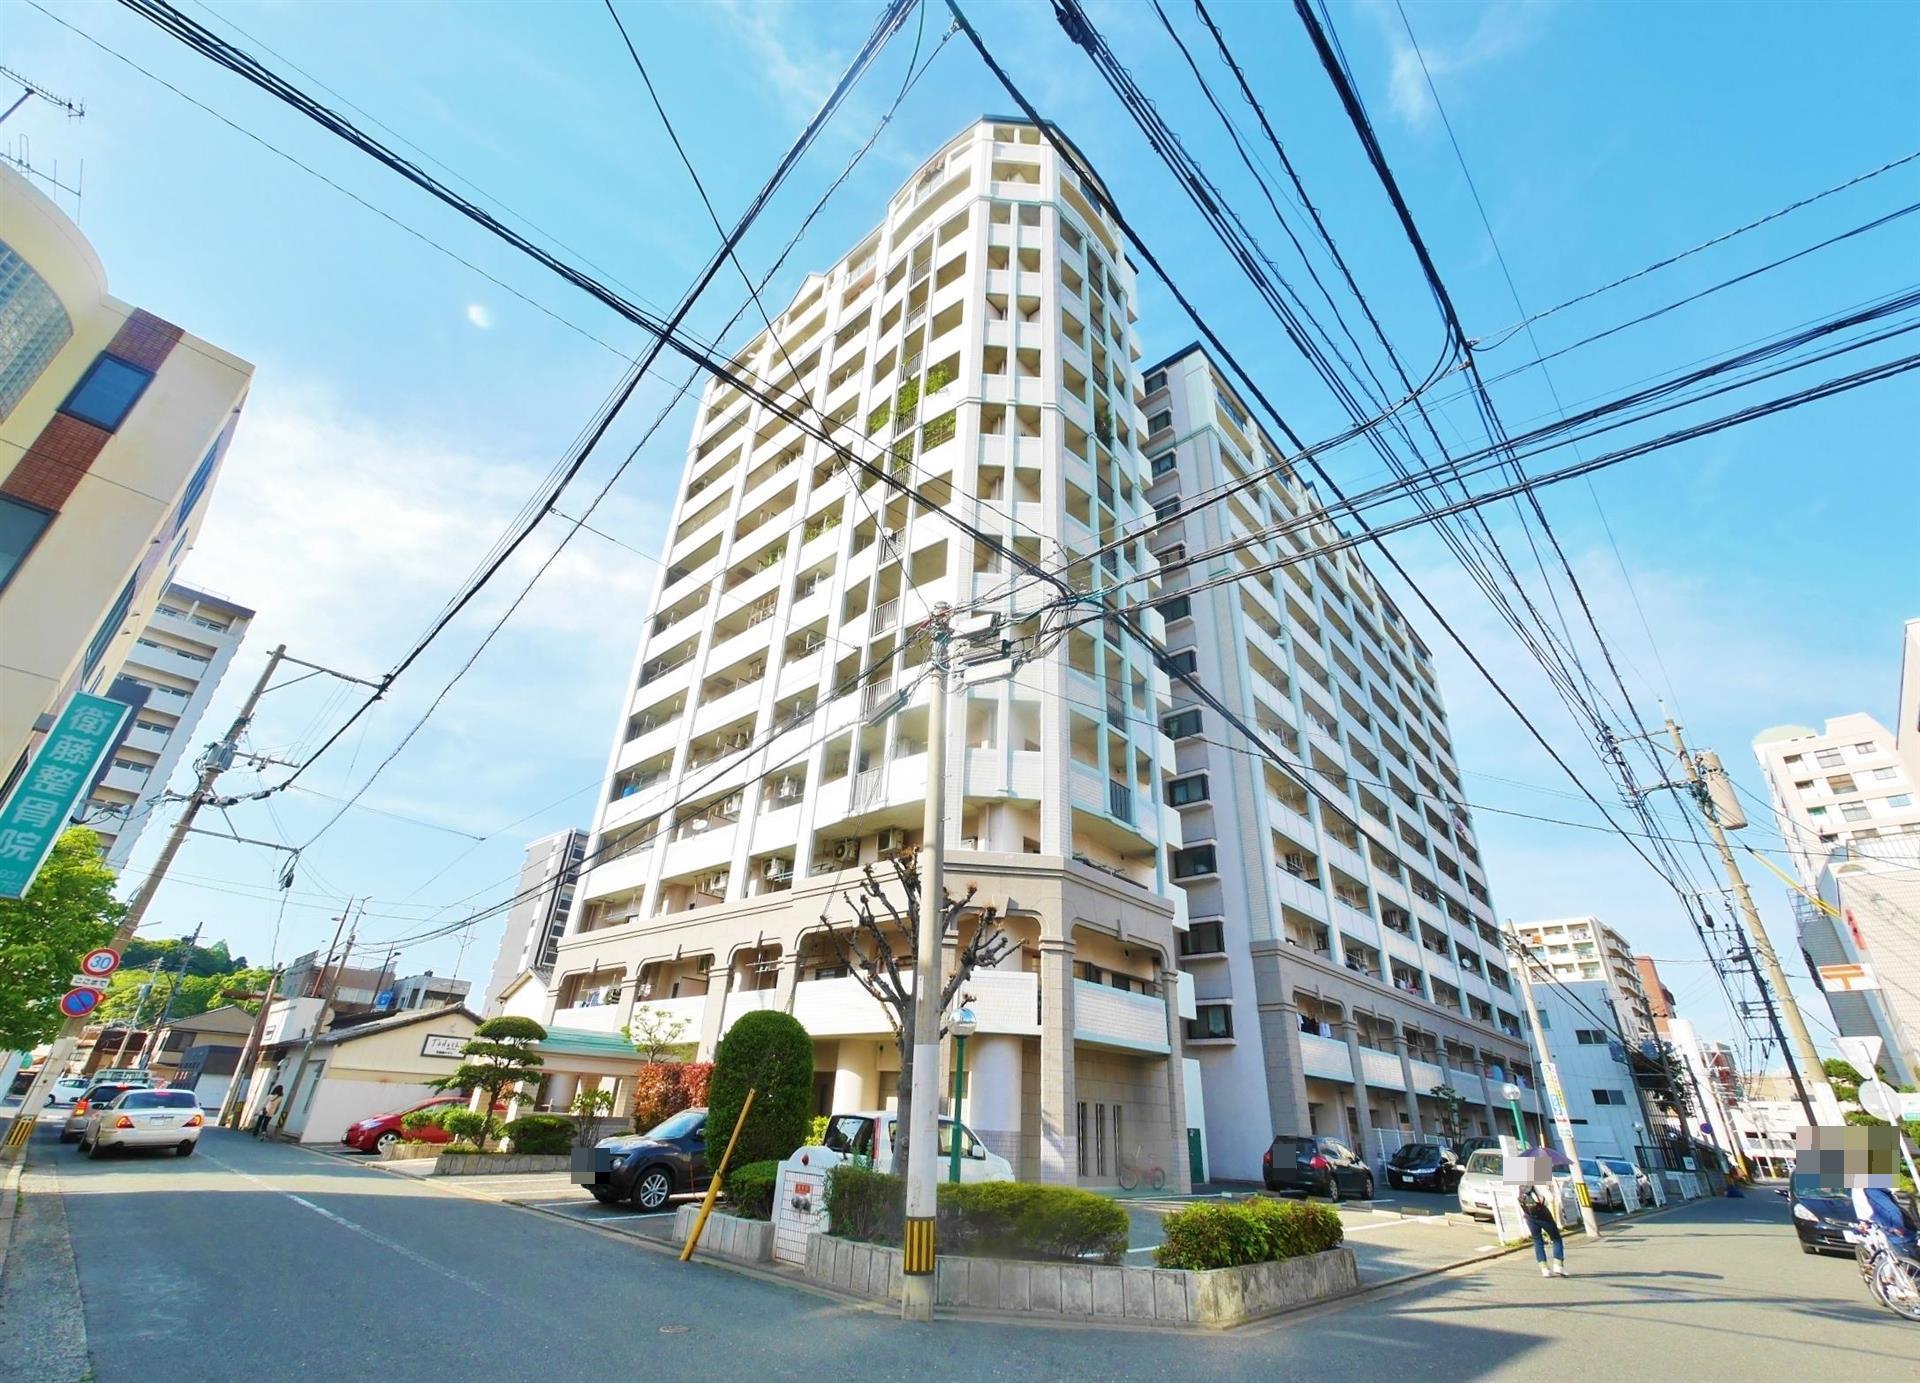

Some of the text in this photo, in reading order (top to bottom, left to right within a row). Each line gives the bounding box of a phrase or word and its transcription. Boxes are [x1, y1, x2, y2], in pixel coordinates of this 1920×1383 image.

[0, 705, 114, 862] 衛藤整骨院
[90, 955, 112, 969] 30
[74, 977, 107, 987] ここまで
